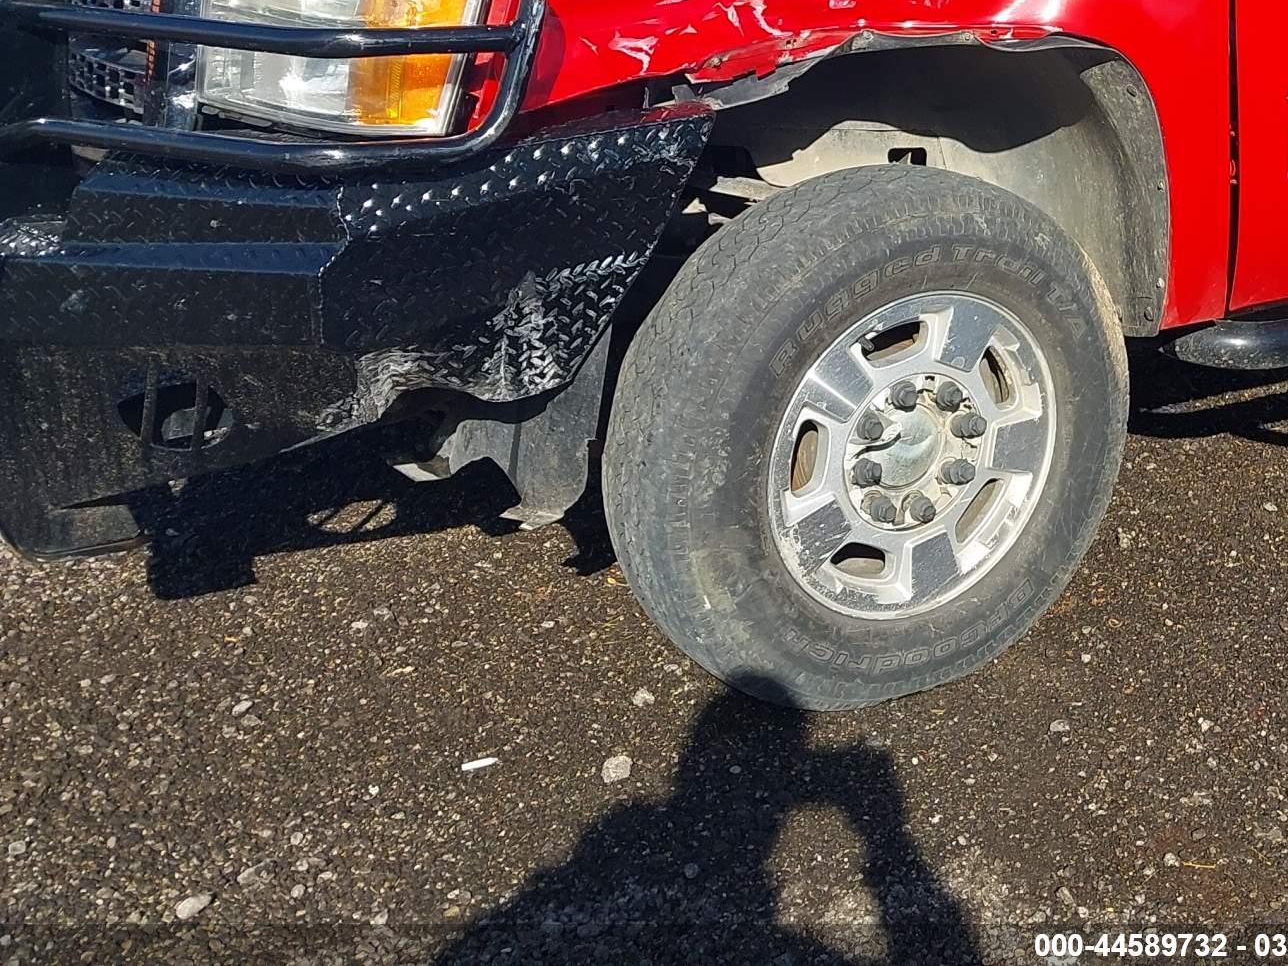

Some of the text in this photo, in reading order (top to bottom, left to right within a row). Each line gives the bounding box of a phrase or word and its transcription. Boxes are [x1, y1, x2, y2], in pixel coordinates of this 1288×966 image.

[768, 244, 942, 378] Rugged
[951, 243, 1046, 290] Trail
[780, 577, 1034, 675] BFGoodrich
